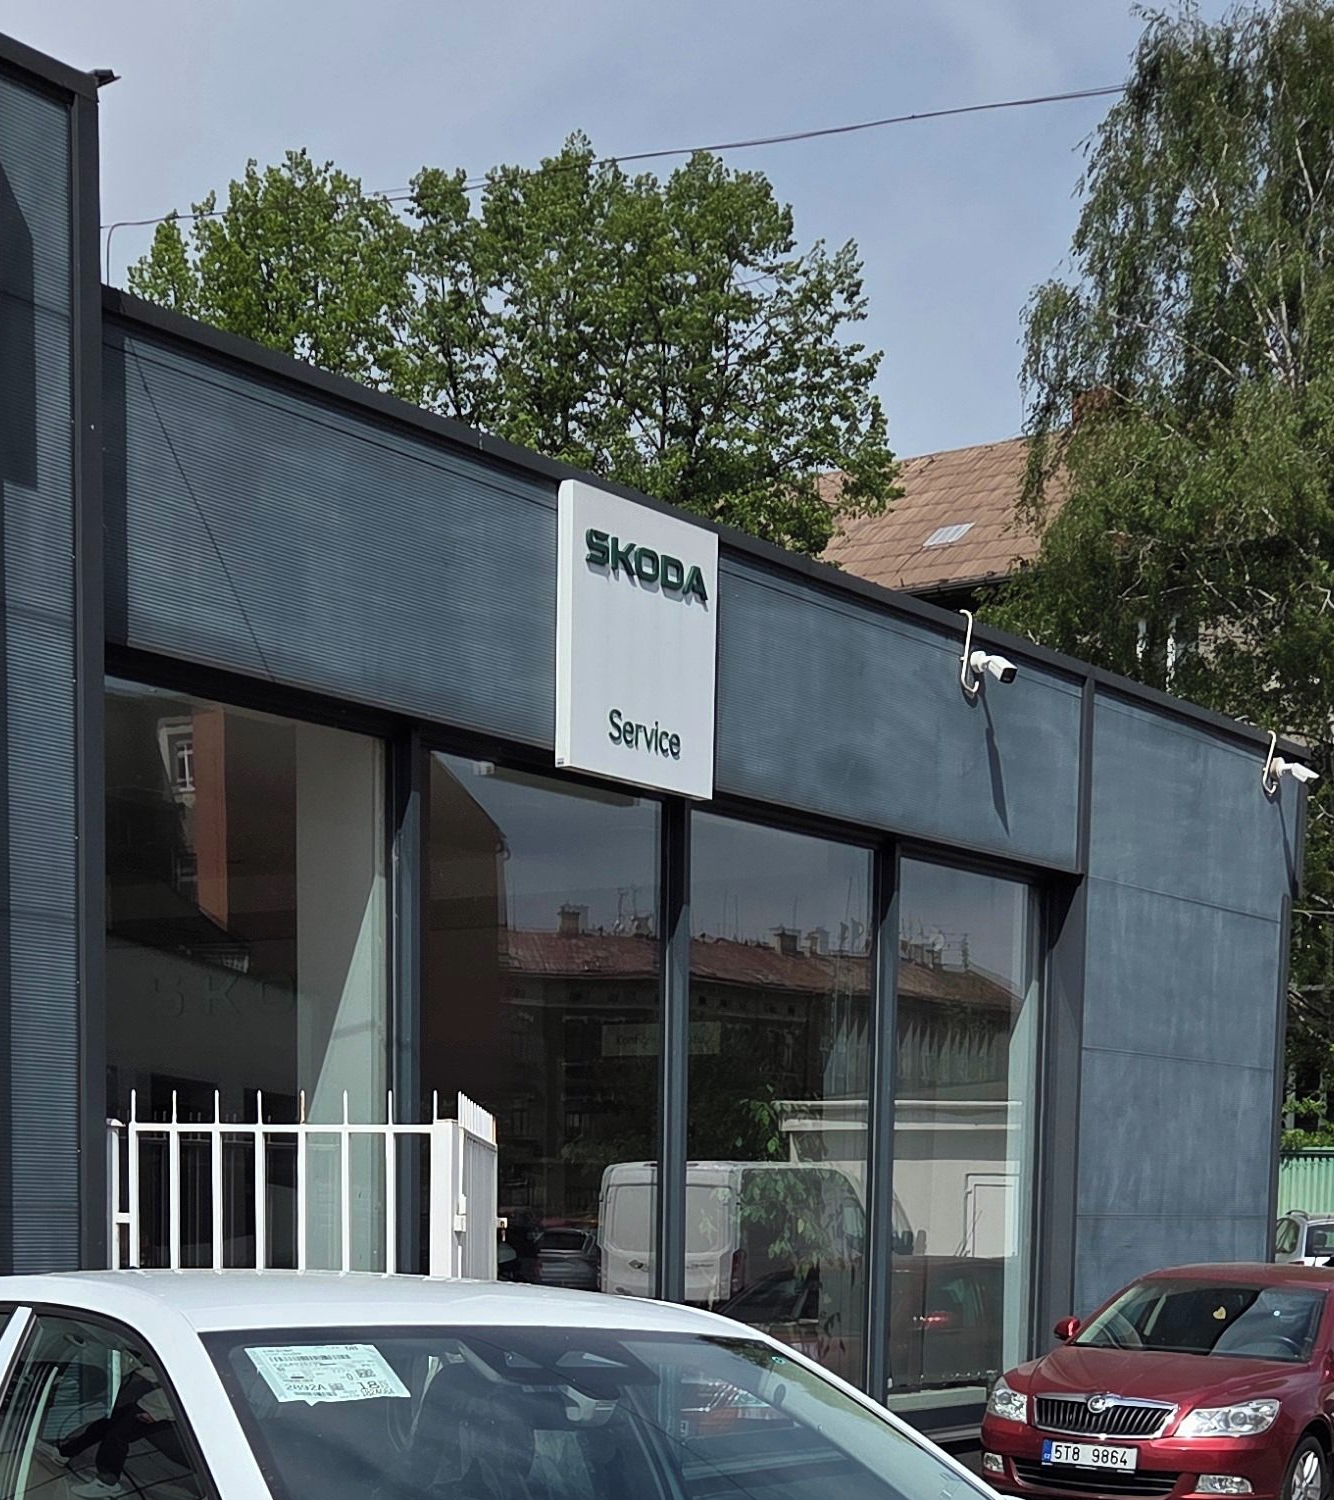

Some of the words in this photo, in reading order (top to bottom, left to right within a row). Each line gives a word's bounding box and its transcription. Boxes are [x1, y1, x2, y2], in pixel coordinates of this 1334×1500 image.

[608, 708, 681, 759] Service
[1054, 1444, 1080, 1462] 5T8
[1091, 1448, 1127, 1467] 9864
